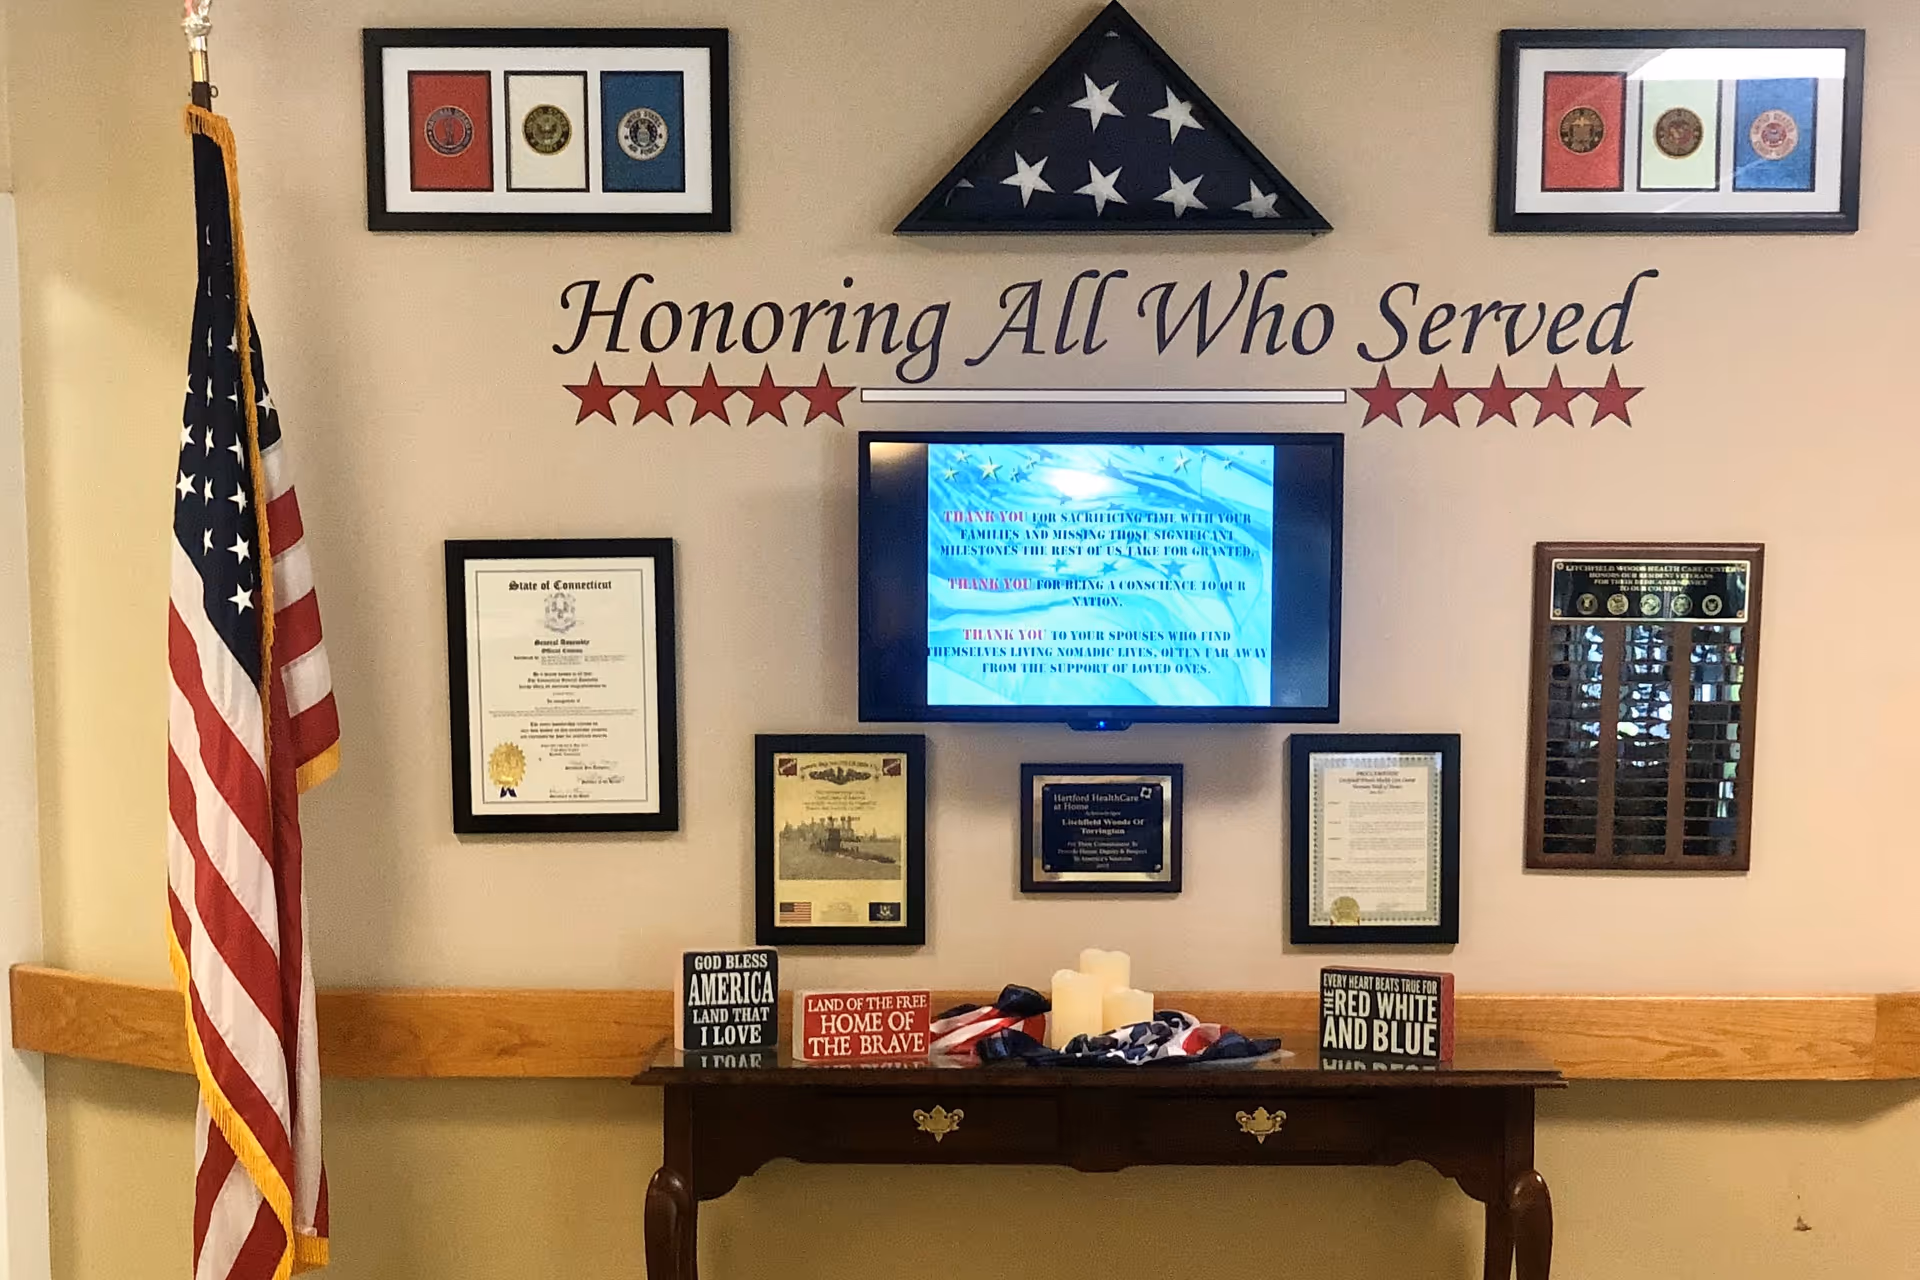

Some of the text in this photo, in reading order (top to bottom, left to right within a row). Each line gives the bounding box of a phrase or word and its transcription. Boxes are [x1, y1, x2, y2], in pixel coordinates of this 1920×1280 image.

[552, 268, 1660, 384] Honoring All Who Served
[944, 510, 1251, 524] THANK YOU FOR SACRIFICING TIME WITH YOUR
[960, 529, 1234, 541] FAMILIES AND MISSING THOSE SIGNIFICANT
[940, 545, 1018, 556] MILESTONES
[1023, 545, 1047, 556] THE
[1052, 545, 1082, 556] REST
[1086, 545, 1102, 556] OF
[1107, 546, 1122, 556] US
[1127, 546, 1159, 556] TAKE
[1164, 546, 1188, 556] FOR
[508, 580, 612, 591] State of Connecticut
[949, 577, 1246, 591] THANK YOU FOR BEING A CONSCIENCE TO OUR
[1072, 596, 1123, 607] NATION.
[963, 629, 1231, 642] THANK YOU TO YOUR SPOUSES WHO FIND
[927, 646, 1006, 657] THEMSELVES
[1010, 646, 1052, 657] LIVING
[1057, 647, 1114, 657] NOMADIC
[1161, 647, 1201, 658] OFTEN
[1206, 648, 1229, 658] FAR
[1233, 648, 1267, 658] AWAY
[982, 663, 1017, 673] FROM
[1021, 663, 1046, 673] THE
[1050, 663, 1109, 674] SUPPORT
[1112, 663, 1128, 674] OF
[1132, 663, 1171, 674] LOVED
[1053, 793, 1139, 803] Hartford HealthCare
[1064, 802, 1089, 810] Home
[1132, 818, 1144, 826] Of
[694, 953, 768, 971] GOD BLESS
[688, 971, 774, 1007] AMERICA
[1323, 973, 1438, 995] EVERY HEART BEATS TRUE FOR
[807, 994, 927, 1012] LAND OF THE FREE
[1323, 988, 1335, 1017] THE
[1334, 989, 1438, 1023] RED WHITE
[693, 1006, 770, 1024] LAND THAT
[820, 1011, 915, 1034] HOME OF
[700, 1024, 762, 1046] I LOVE
[1322, 1016, 1437, 1057] AND BLUE
[808, 1032, 925, 1057] THE BRAVE
